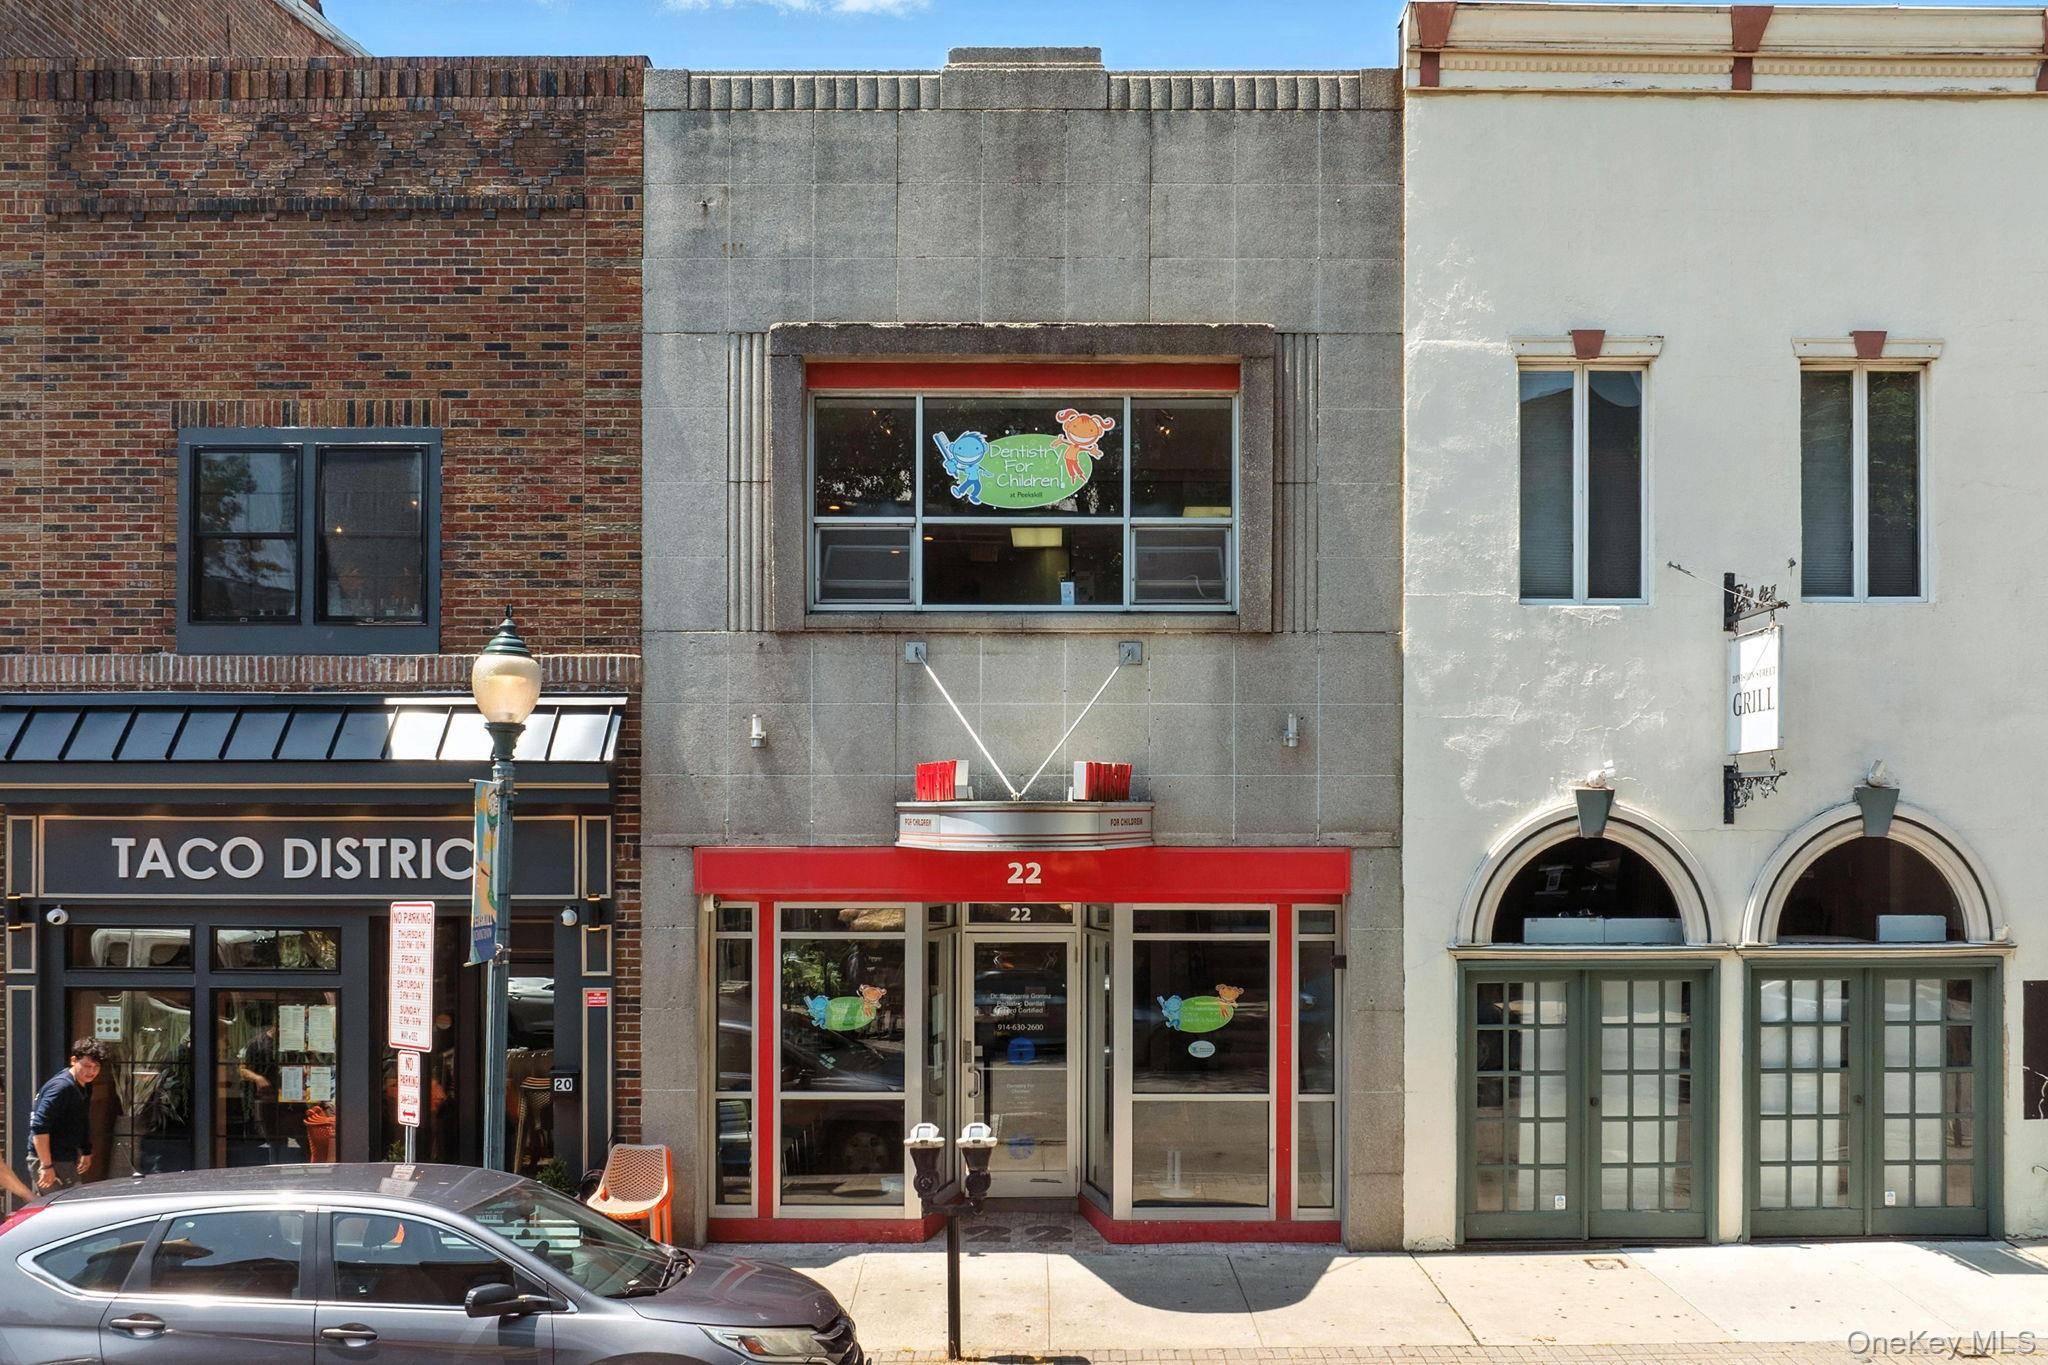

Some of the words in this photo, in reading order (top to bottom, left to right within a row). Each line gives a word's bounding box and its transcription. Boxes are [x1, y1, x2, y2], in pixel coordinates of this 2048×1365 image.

[990, 444, 1063, 464] Dentistry
[1004, 460, 1034, 472] For
[996, 465, 1066, 489] Children!
[1733, 687, 1774, 716] GRILL
[112, 836, 265, 880] TACO
[284, 837, 474, 880] DISTRIC
[1007, 862, 1042, 884] 22
[394, 912, 402, 924] NO
[404, 912, 431, 924] PARKING
[1010, 907, 1032, 922] 22
[398, 930, 425, 939] THURSDAY
[401, 955, 421, 964] FRIDAY
[397, 980, 424, 989] SATURDAY
[400, 1005, 421, 1015] SUNDAY
[405, 1057, 414, 1071] NO
[556, 1079, 572, 1090] 20
